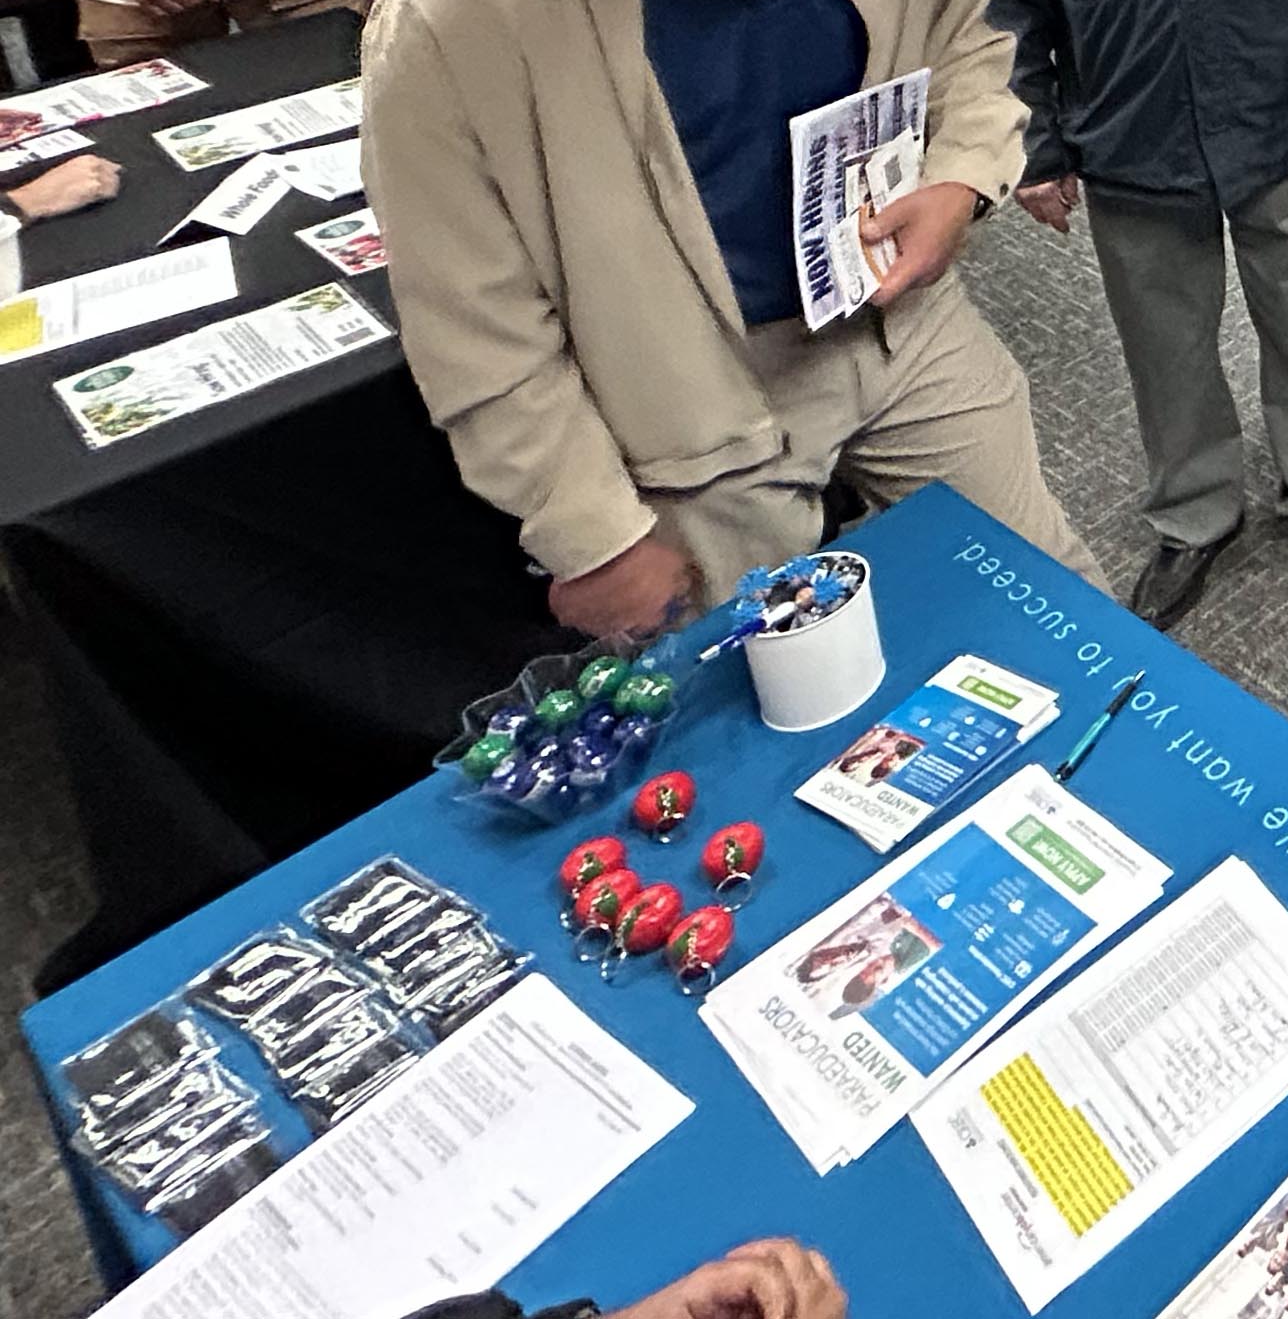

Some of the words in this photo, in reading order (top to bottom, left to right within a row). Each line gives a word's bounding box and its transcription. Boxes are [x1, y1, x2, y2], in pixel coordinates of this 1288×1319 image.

[218, 193, 258, 219] Whole
[800, 134, 829, 233] HIRING
[801, 235, 835, 303] NOW
[953, 535, 1078, 641] succeed.
[1076, 641, 1114, 678] to
[1165, 727, 1255, 807] want
[876, 789, 922, 818] WANTED
[758, 995, 882, 1118] PARAEDUCATORS
[842, 1030, 908, 1094] WANTED
